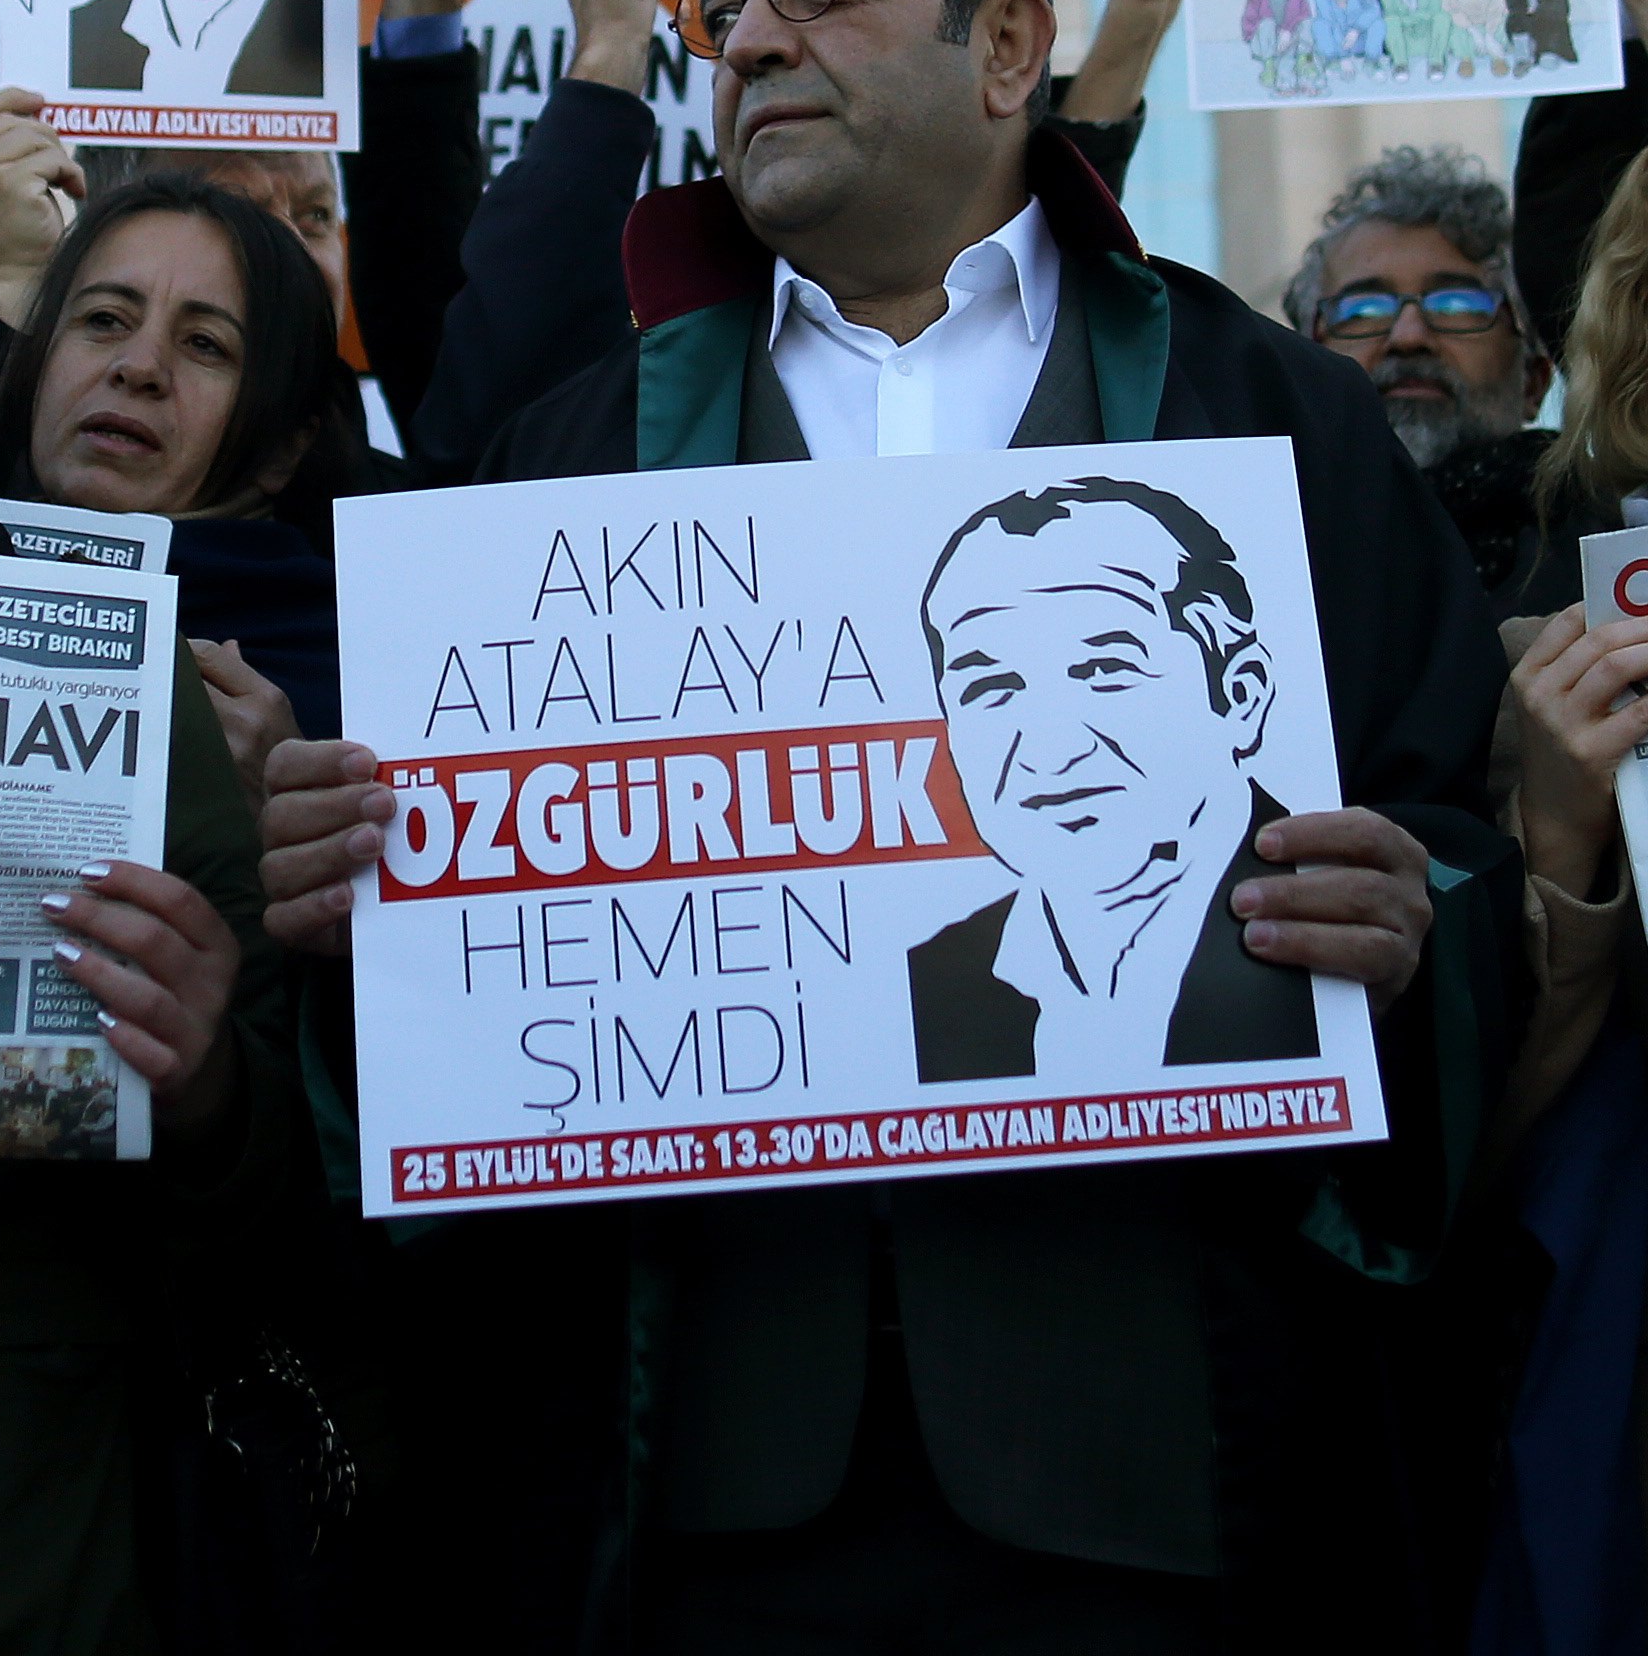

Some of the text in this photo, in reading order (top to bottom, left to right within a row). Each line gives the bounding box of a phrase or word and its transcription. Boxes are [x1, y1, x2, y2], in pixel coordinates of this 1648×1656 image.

[532, 516, 760, 620] AKIN
[0, 674, 53, 692] tutuklu
[56, 679, 140, 701] yargılanıyor
[48, 633, 132, 661] BIRAKIN
[425, 615, 886, 737] ATALAY'A
[383, 738, 948, 882] ÖZGÜRLÜK
[461, 880, 852, 995] HEMEN
[521, 981, 811, 1136] ŞİMDİ
[403, 1086, 1341, 1193] 25 EYLÜL'DE SAAT: 13.30'DA ÇAĞLAYAN ADLİYESİ'NDEYİZ
